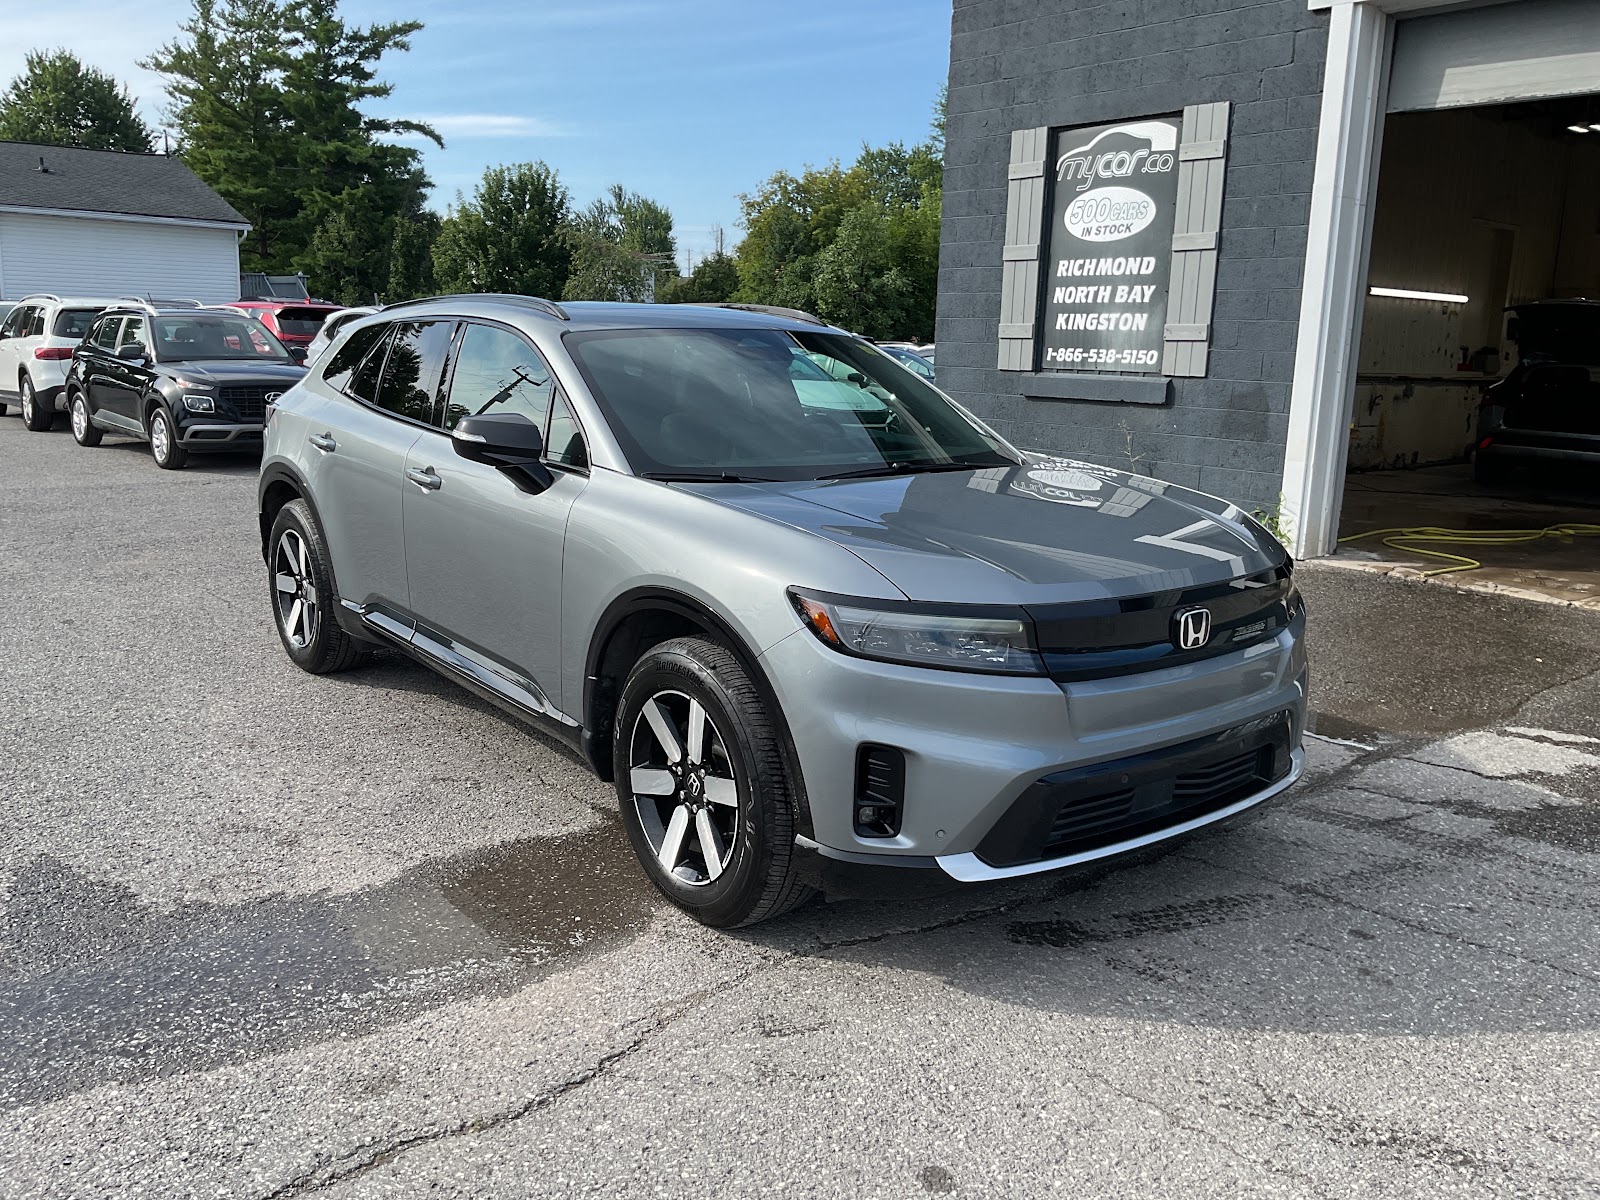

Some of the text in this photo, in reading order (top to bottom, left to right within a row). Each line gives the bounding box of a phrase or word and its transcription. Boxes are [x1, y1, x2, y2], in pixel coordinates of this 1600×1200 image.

[1081, 223, 1134, 237] IN STOCK
[1057, 257, 1156, 277] RICHMOND
[1053, 285, 1156, 303] NORTH BAY
[1055, 313, 1148, 331] KINGSTON
[1046, 348, 1158, 364] 1-866-538-5150
